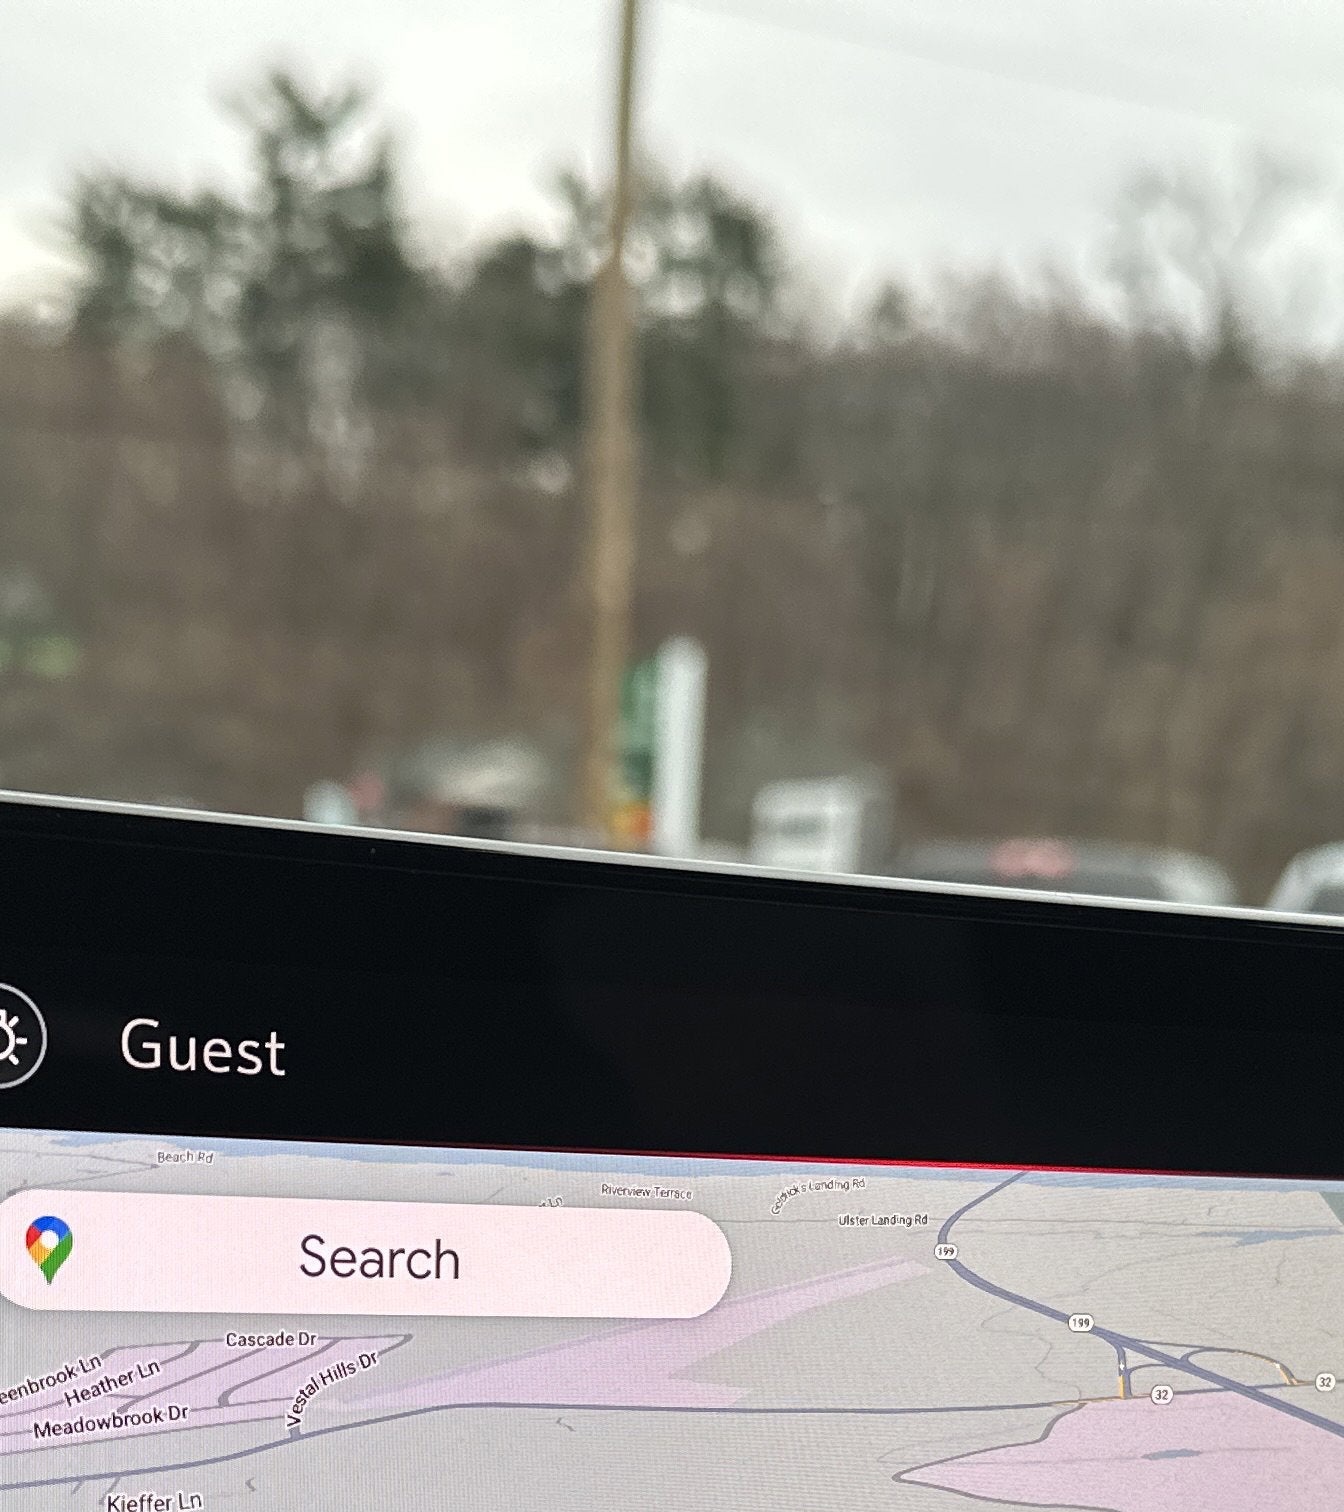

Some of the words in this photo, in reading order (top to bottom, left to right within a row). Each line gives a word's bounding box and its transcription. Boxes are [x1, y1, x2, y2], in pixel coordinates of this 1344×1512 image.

[120, 1017, 287, 1077] Guest
[157, 1150, 194, 1164] Beach
[197, 1151, 214, 1164] Rd
[601, 1183, 651, 1198] Riverview
[838, 1213, 869, 1226] Ulster
[872, 1213, 913, 1227] Landing
[914, 1213, 928, 1225] Rd
[299, 1232, 460, 1280] Search
[1071, 1316, 1091, 1329] 199
[226, 1331, 295, 1347] Cascade
[298, 1331, 317, 1346] Dr
[79, 1355, 102, 1373] Ln
[64, 1370, 135, 1407] Heather
[138, 1360, 161, 1379] Ln
[286, 1376, 320, 1427] Vestal
[318, 1361, 357, 1386] Hills
[358, 1352, 377, 1369] Dr
[1319, 1376, 1333, 1389] 32
[1154, 1388, 1169, 1401] 32
[33, 1408, 165, 1439] Meadowbrook
[168, 1404, 188, 1421] Dr
[179, 1492, 203, 1510] Ln
